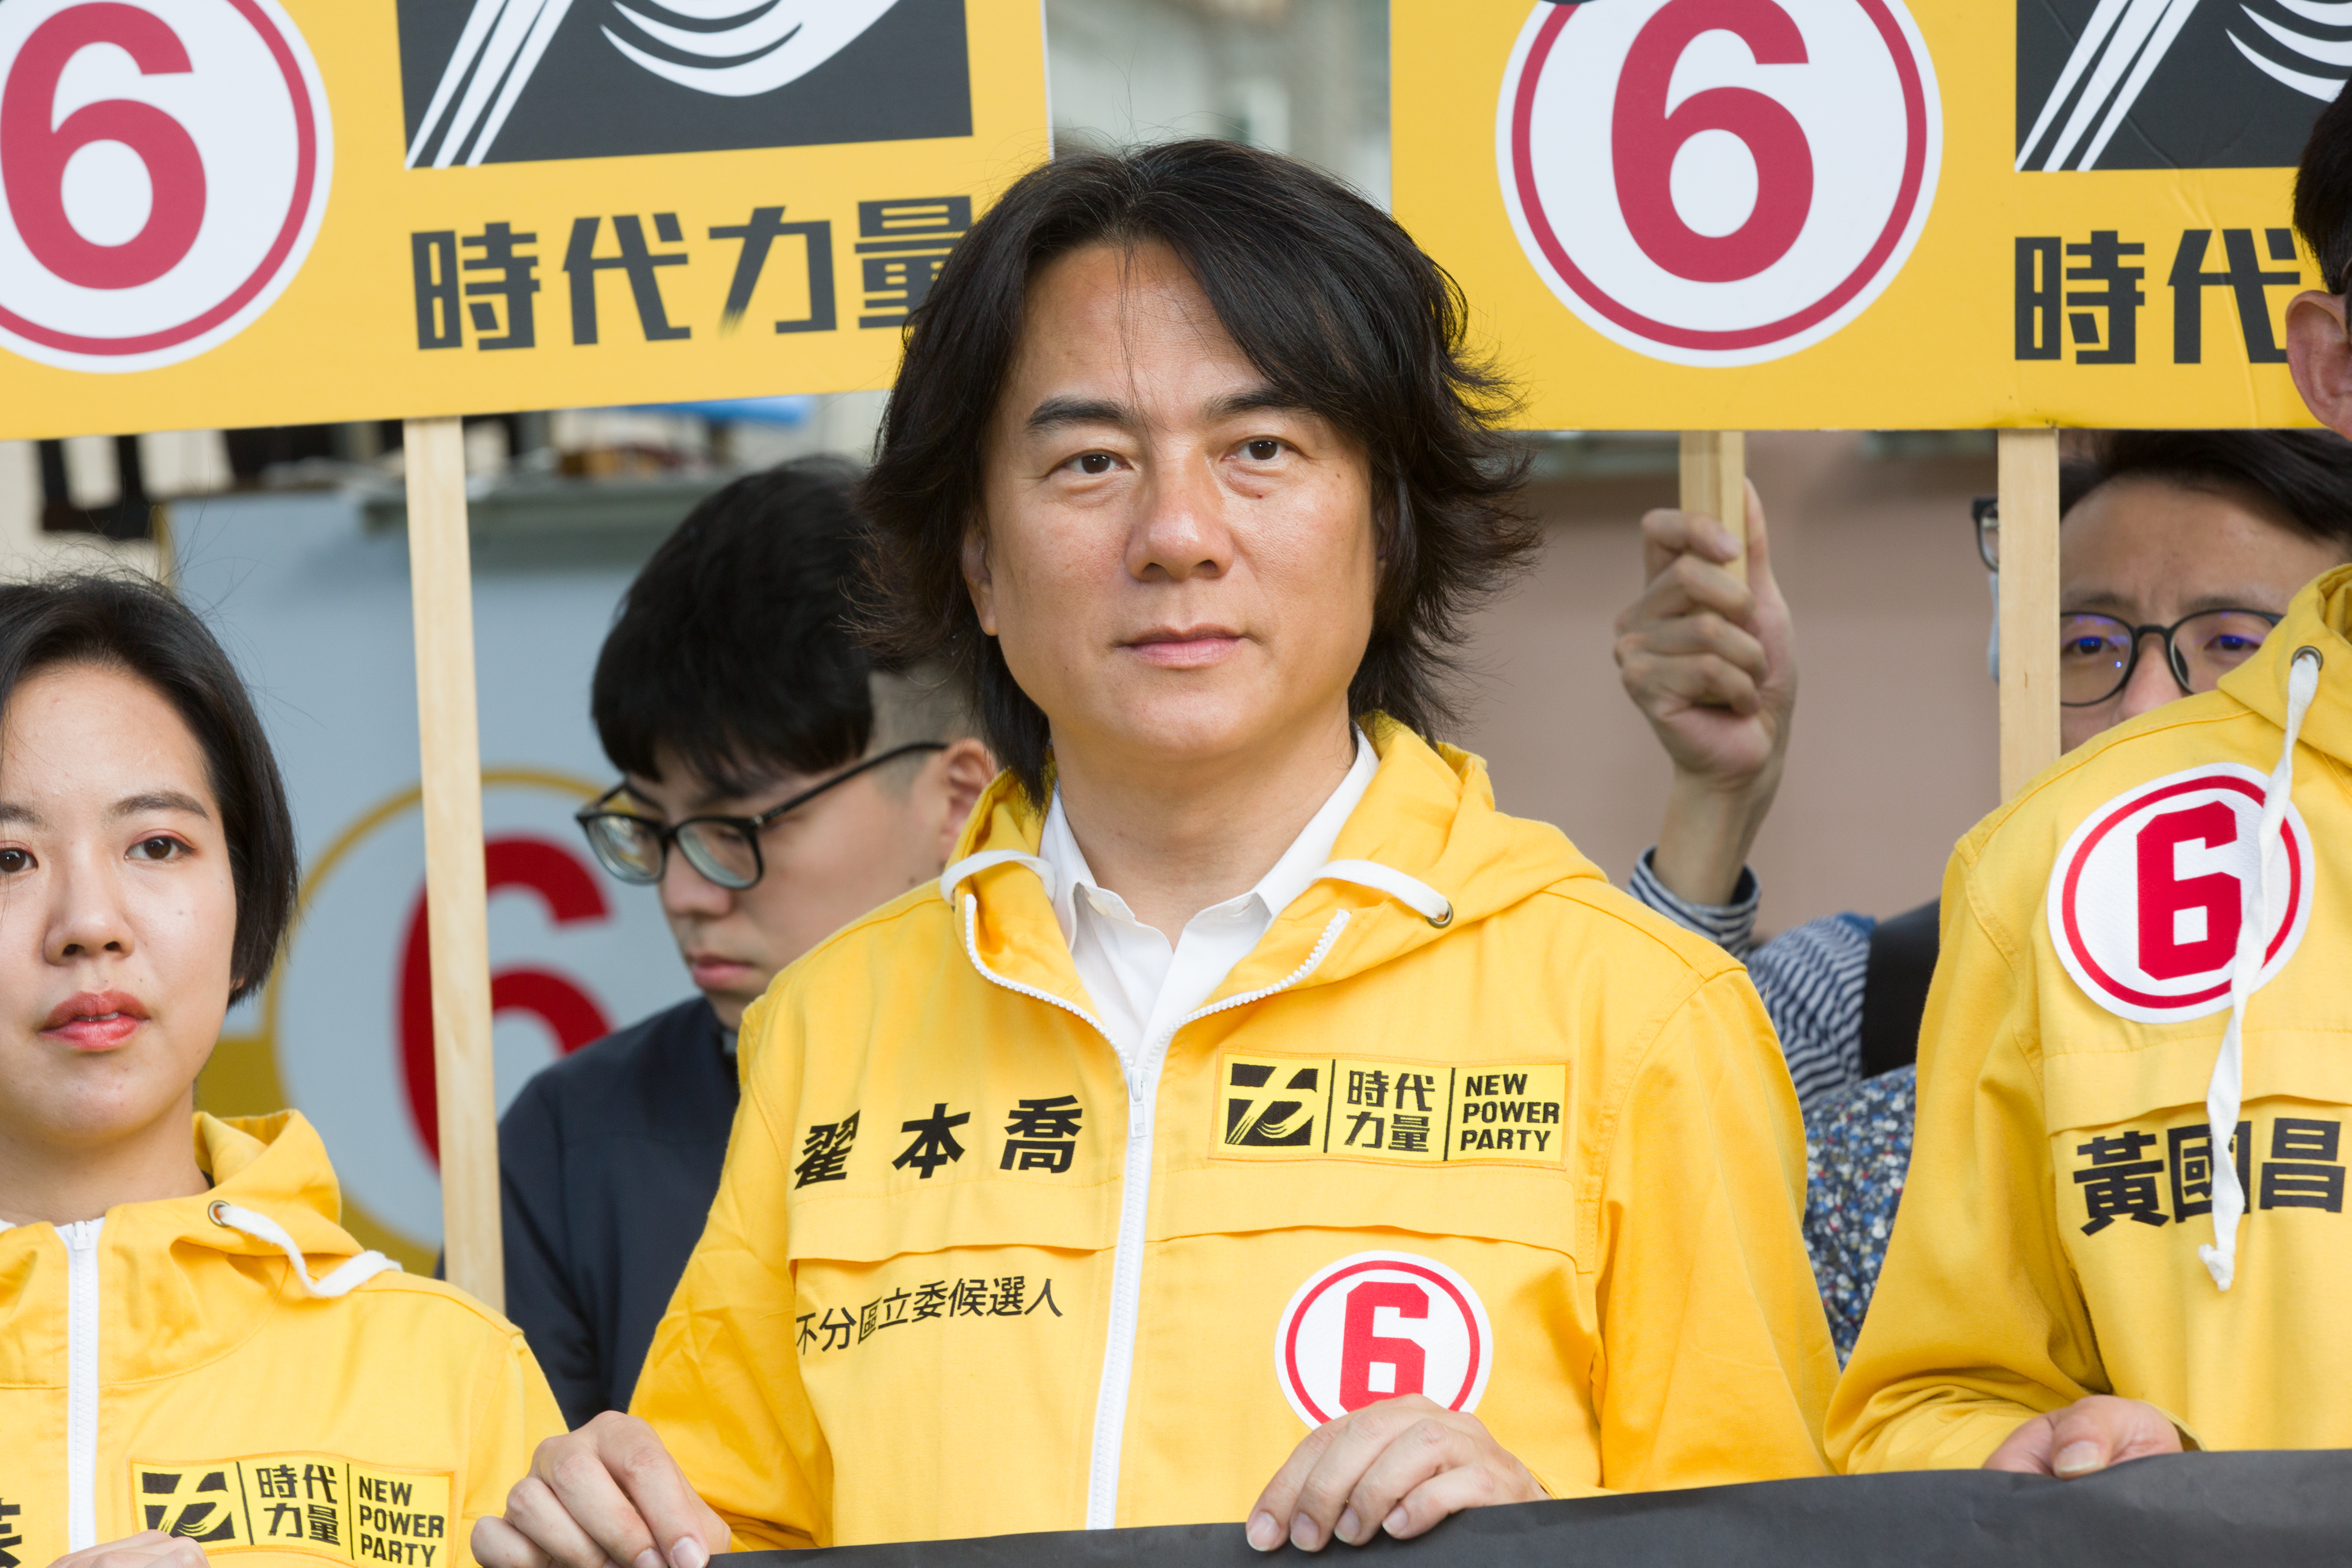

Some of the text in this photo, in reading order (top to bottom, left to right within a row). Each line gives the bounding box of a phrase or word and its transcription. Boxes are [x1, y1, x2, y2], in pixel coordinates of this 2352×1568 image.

[0, 2, 206, 290] 6
[1611, 0, 1814, 283] 6
[412, 195, 972, 351] 時代力量
[2015, 228, 2301, 364] 時代
[2136, 800, 2243, 981] 6
[1347, 1070, 1436, 1112] 時代
[1465, 1073, 1528, 1097] NEW
[1343, 1111, 1431, 1153] 力量
[1462, 1101, 1560, 1124] POWER
[794, 1094, 1083, 1190] 翟本喬
[1460, 1128, 1551, 1152] PARTY
[796, 1276, 1063, 1356] 不分區立委候選人
[1339, 1281, 1429, 1413] 6
[256, 1463, 337, 1504] 時代
[359, 1476, 412, 1507] NEW
[264, 1502, 341, 1546] 力量
[359, 1504, 445, 1538] POWER
[360, 1532, 436, 1568] PARTY
